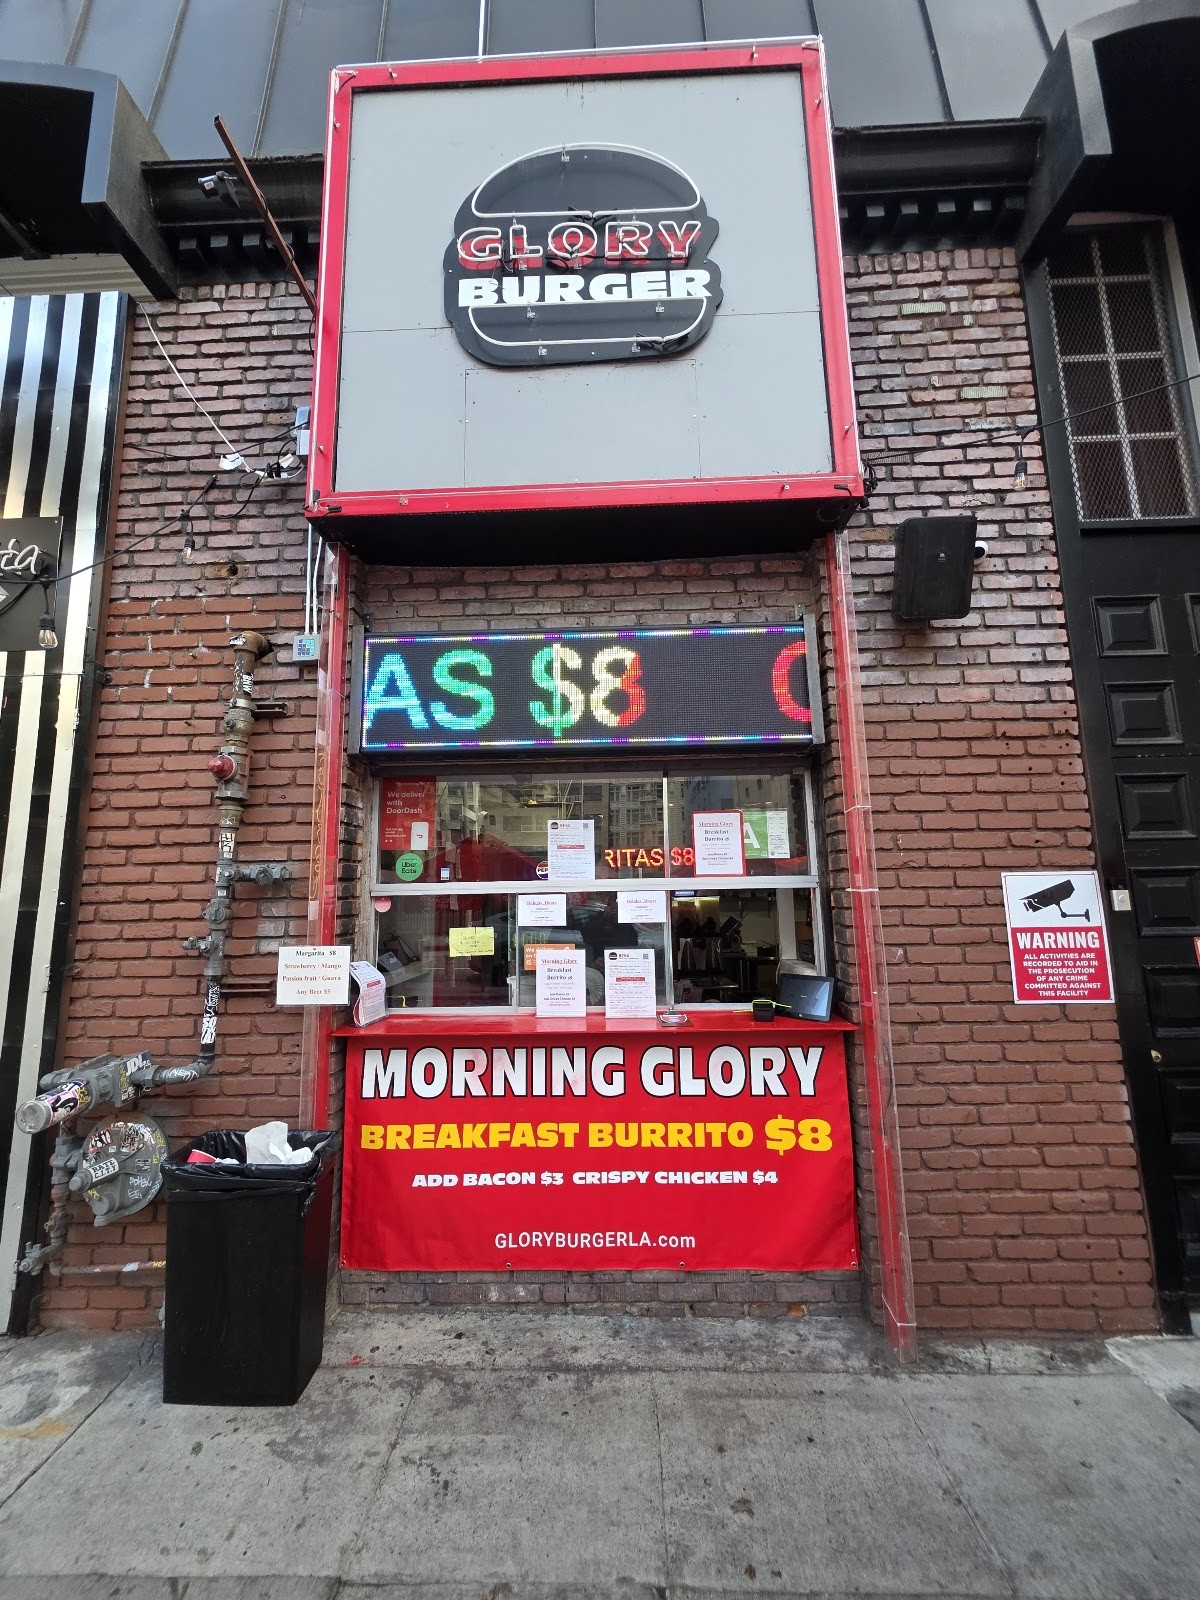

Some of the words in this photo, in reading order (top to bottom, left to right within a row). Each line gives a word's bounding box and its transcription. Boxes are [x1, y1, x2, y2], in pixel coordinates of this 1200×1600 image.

[457, 221, 701, 269] GLORY
[459, 269, 712, 307] BURGER
[364, 649, 496, 731] AS
[529, 642, 646, 737] $8
[743, 822, 760, 848] A
[670, 846, 694, 866] $8
[1017, 932, 1099, 948] WARNING
[361, 1045, 626, 1099] MORNING
[640, 1044, 825, 1098] GLORY
[361, 1122, 580, 1150] BREAKFAST
[588, 1121, 754, 1148] BURRITO
[764, 1114, 833, 1156] $8
[412, 1174, 458, 1188] ADD
[463, 1172, 536, 1186] BACON
[541, 1171, 564, 1186] $3
[572, 1171, 650, 1185] CRISPY
[654, 1170, 748, 1184] CHICKEN
[753, 1170, 778, 1185] $4
[494, 1232, 696, 1248] GLORYBURGERLA.com
